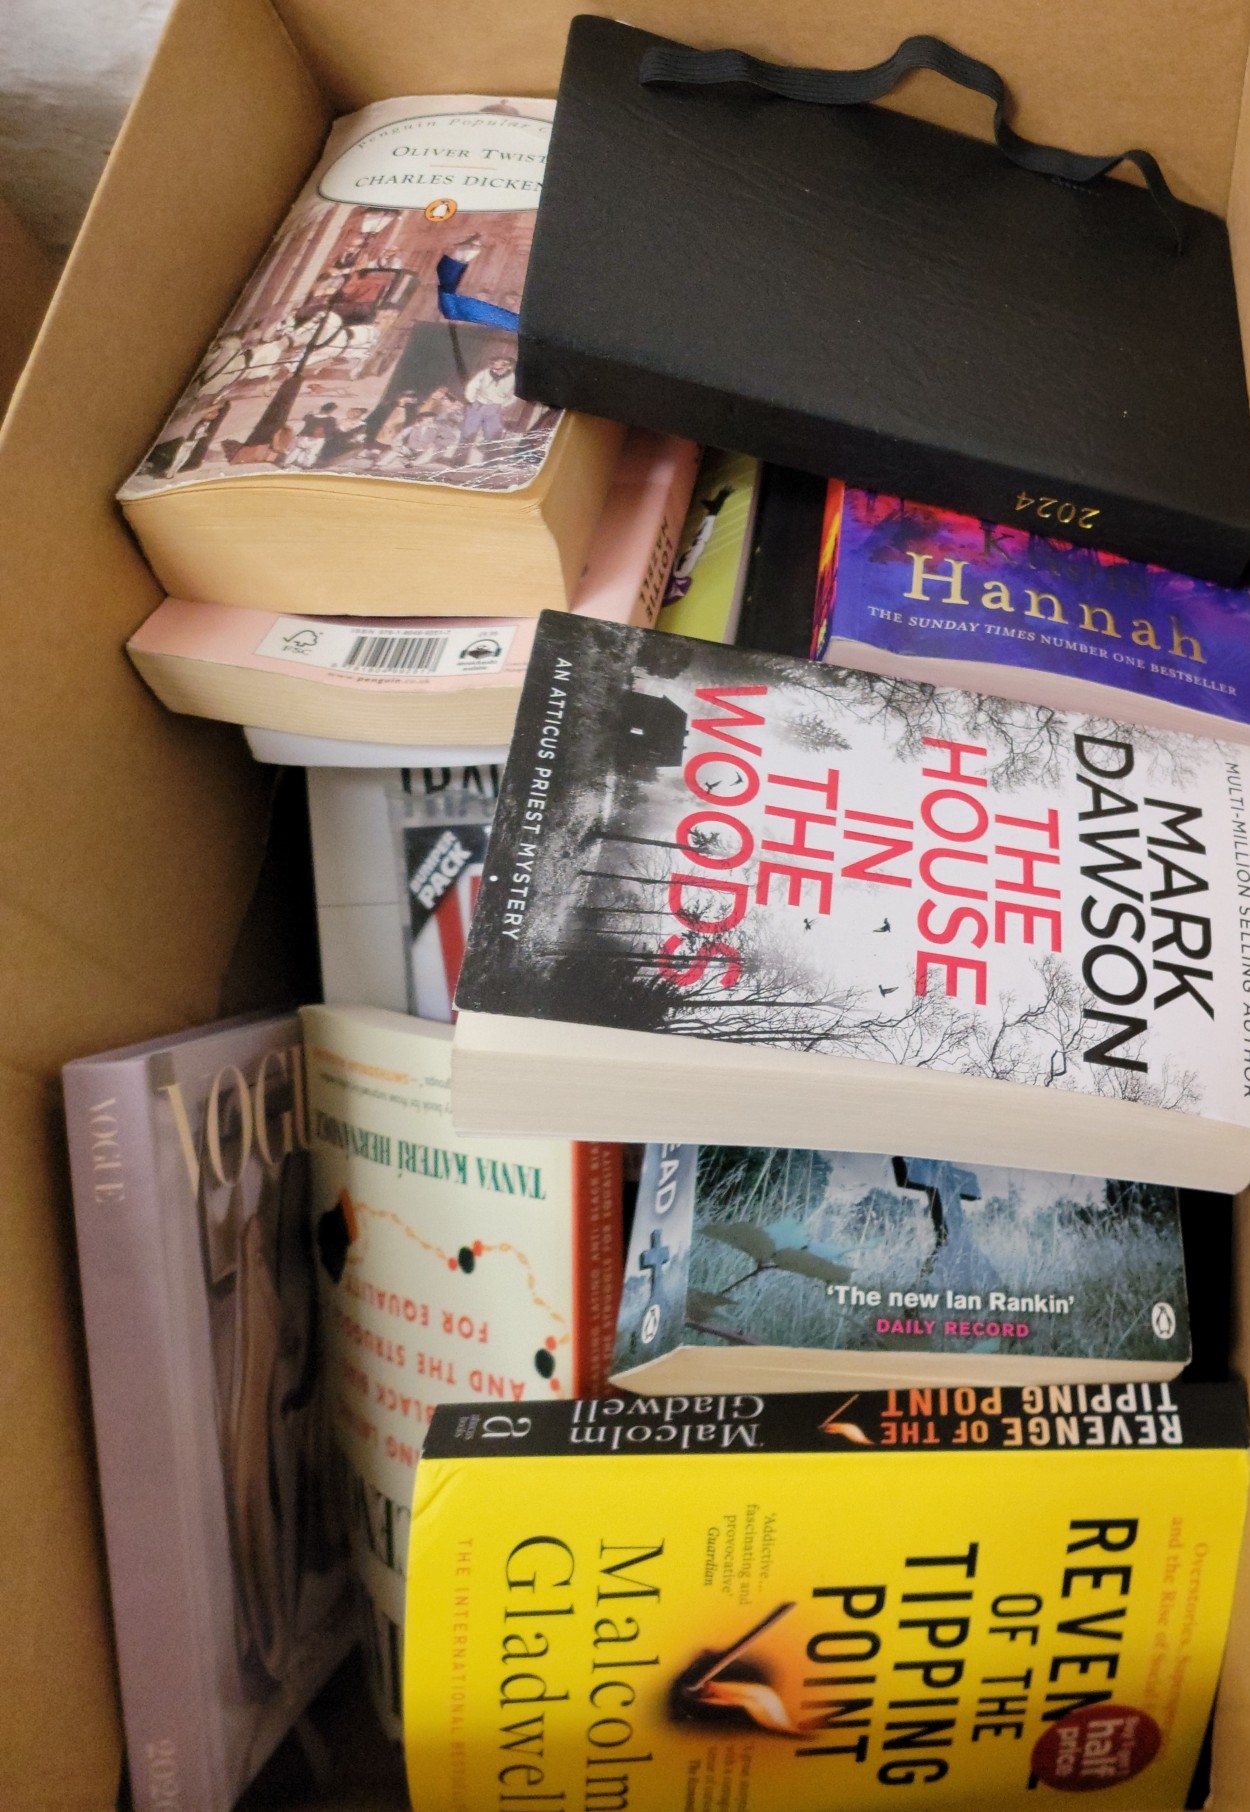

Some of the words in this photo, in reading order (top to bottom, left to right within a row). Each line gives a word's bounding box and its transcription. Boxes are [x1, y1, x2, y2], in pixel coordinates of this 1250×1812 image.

[392, 146, 470, 158] OLIVER
[483, 149, 548, 164] TWIST
[449, 118, 531, 132] Popular
[355, 174, 454, 188] CHARLES
[463, 176, 543, 192] DICKEN
[1015, 491, 1101, 529] 2024
[903, 550, 1208, 664] Hannah
[549, 656, 573, 683] AN
[867, 605, 904, 625] THE
[908, 616, 980, 634] SUNDAY
[984, 623, 1037, 642] TIMES
[1040, 634, 1109, 659] NUMBER
[1113, 652, 1147, 670] ONE
[1149, 663, 1238, 697] BESTSELLER
[538, 688, 567, 761] ATTICUS
[525, 766, 553, 836] PRIEST
[658, 684, 768, 989] WOODS
[755, 767, 840, 915] THE
[841, 808, 914, 889] IN
[416, 841, 473, 910] PACK
[502, 842, 538, 941] MYSTERY
[915, 735, 989, 1006] HOUSE
[994, 807, 1062, 954] THE
[1074, 732, 1149, 1073] DAWSON
[1143, 796, 1215, 1021] MARK
[89, 1097, 125, 1204] VOGUE
[158, 1046, 311, 1199] VOG
[476, 1157, 546, 1200] TANYA
[442, 1308, 490, 1344] FOR
[826, 1284, 881, 1306] ‘The
[889, 1290, 941, 1308] new
[945, 1290, 983, 1310] Ian
[990, 1291, 1075, 1314] Rankin’
[876, 1317, 934, 1336] DAILY
[945, 1320, 1030, 1338] RECORD
[416, 1351, 457, 1385] THE
[469, 1369, 526, 1401] AND
[1021, 1382, 1178, 1414] TIPPING
[572, 1395, 765, 1424] Gladwell
[881, 1386, 1002, 1417] POINT
[952, 1420, 989, 1444] OF
[1002, 1414, 1183, 1446] REVENGE
[570, 1423, 762, 1449] Malcolm
[880, 1421, 940, 1445] THE
[456, 1538, 473, 1576] THE
[703, 1526, 720, 1587] Guardian
[738, 1503, 760, 1579] fascinating
[1168, 1516, 1183, 1549] and
[738, 1580, 752, 1606] and
[1163, 1551, 1182, 1583] the
[988, 1593, 1043, 1646] OF
[451, 1588, 470, 1734] INTERNATIONAL
[498, 1535, 575, 1812] Gladwel
[585, 1537, 666, 1812] Malcolm
[795, 1584, 887, 1763] POINT
[877, 1541, 979, 1786] TIPPING
[1027, 1518, 1139, 1790] REVEN
[971, 1667, 1033, 1742] THE
[1080, 1717, 1125, 1779] half
